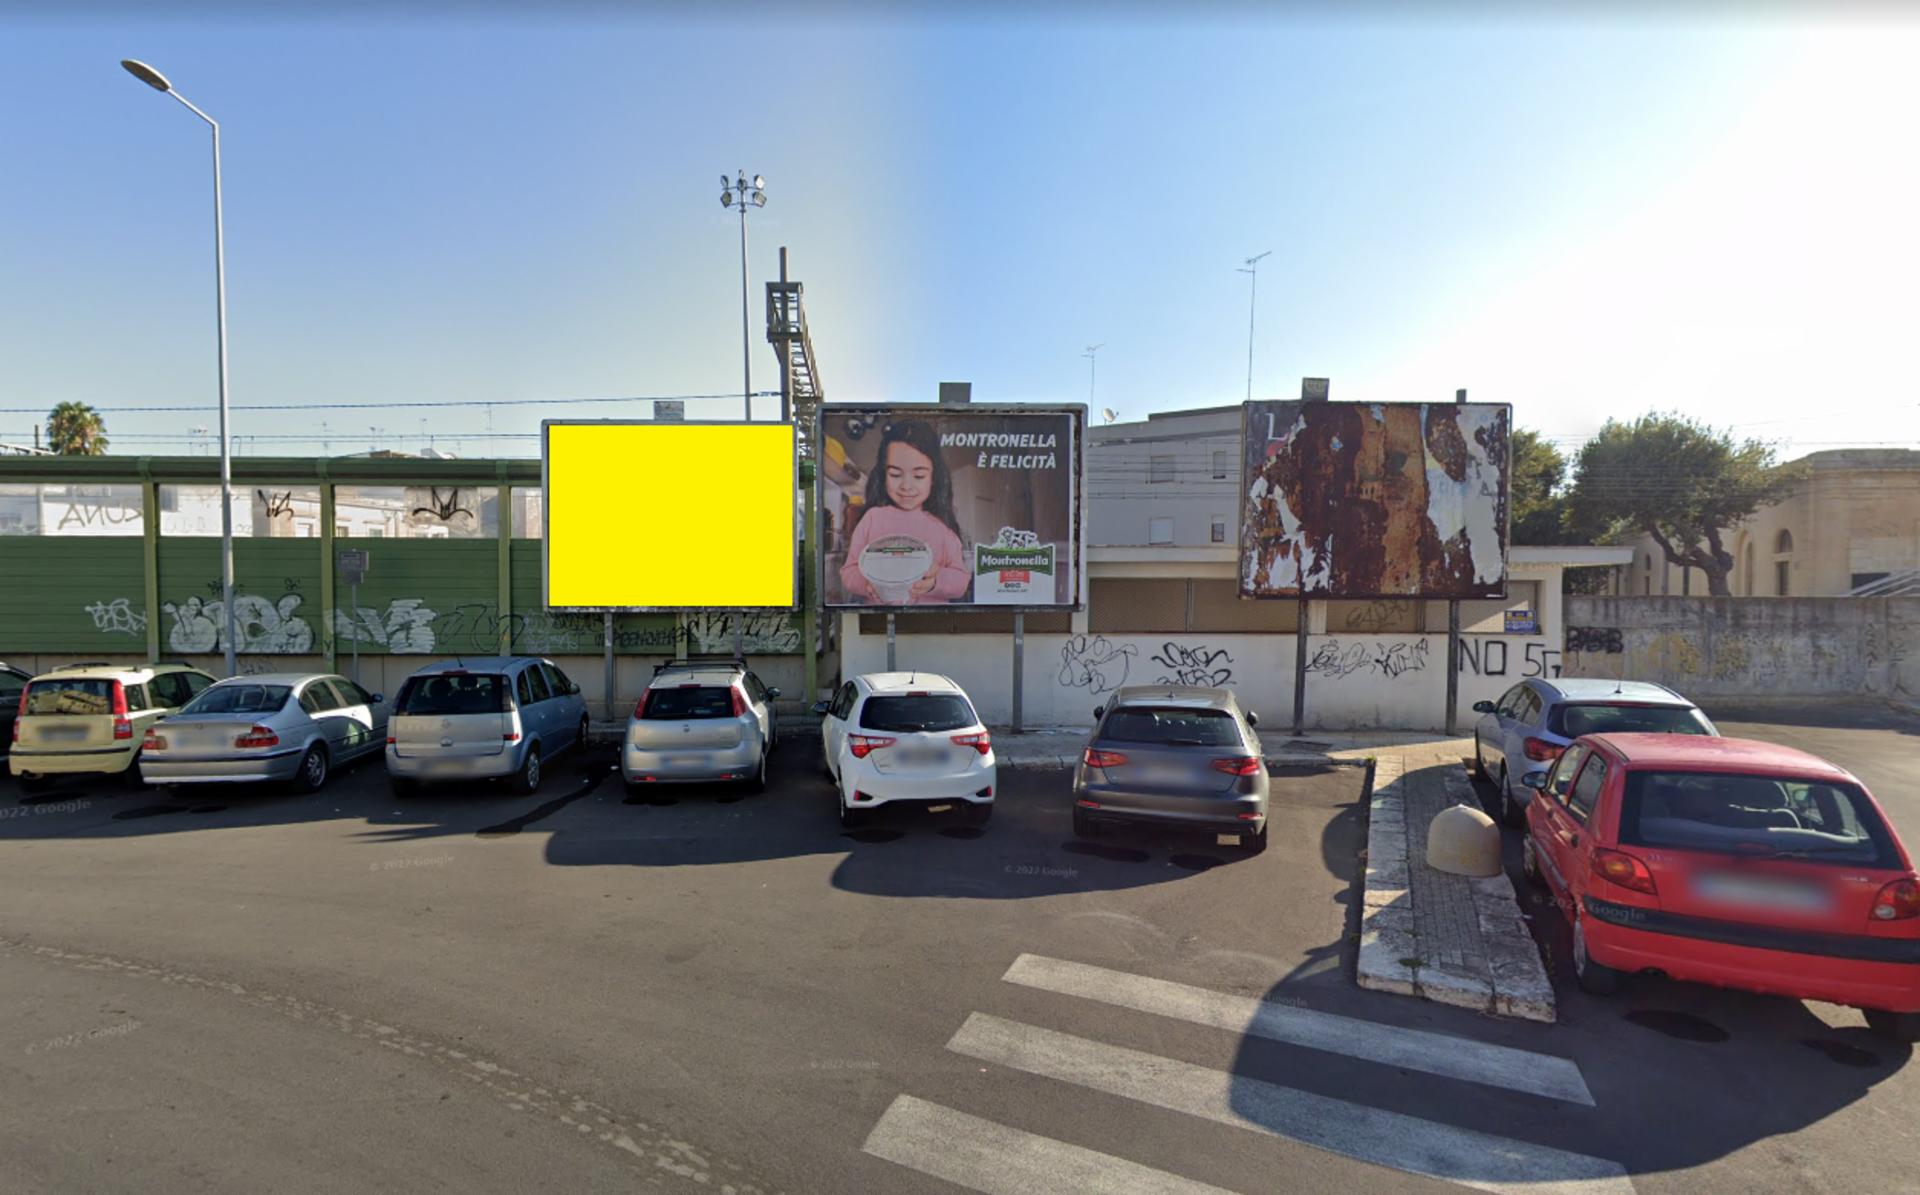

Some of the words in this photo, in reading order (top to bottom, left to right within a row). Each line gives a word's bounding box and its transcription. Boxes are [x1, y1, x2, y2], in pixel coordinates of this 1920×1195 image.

[940, 433, 1056, 448] MONTRONELLA
[977, 451, 987, 468] È
[990, 452, 1056, 469] FELICITÀ
[980, 554, 1048, 567] Montronella
[1459, 639, 1507, 675] NO
[1521, 643, 1562, 679] 5G
